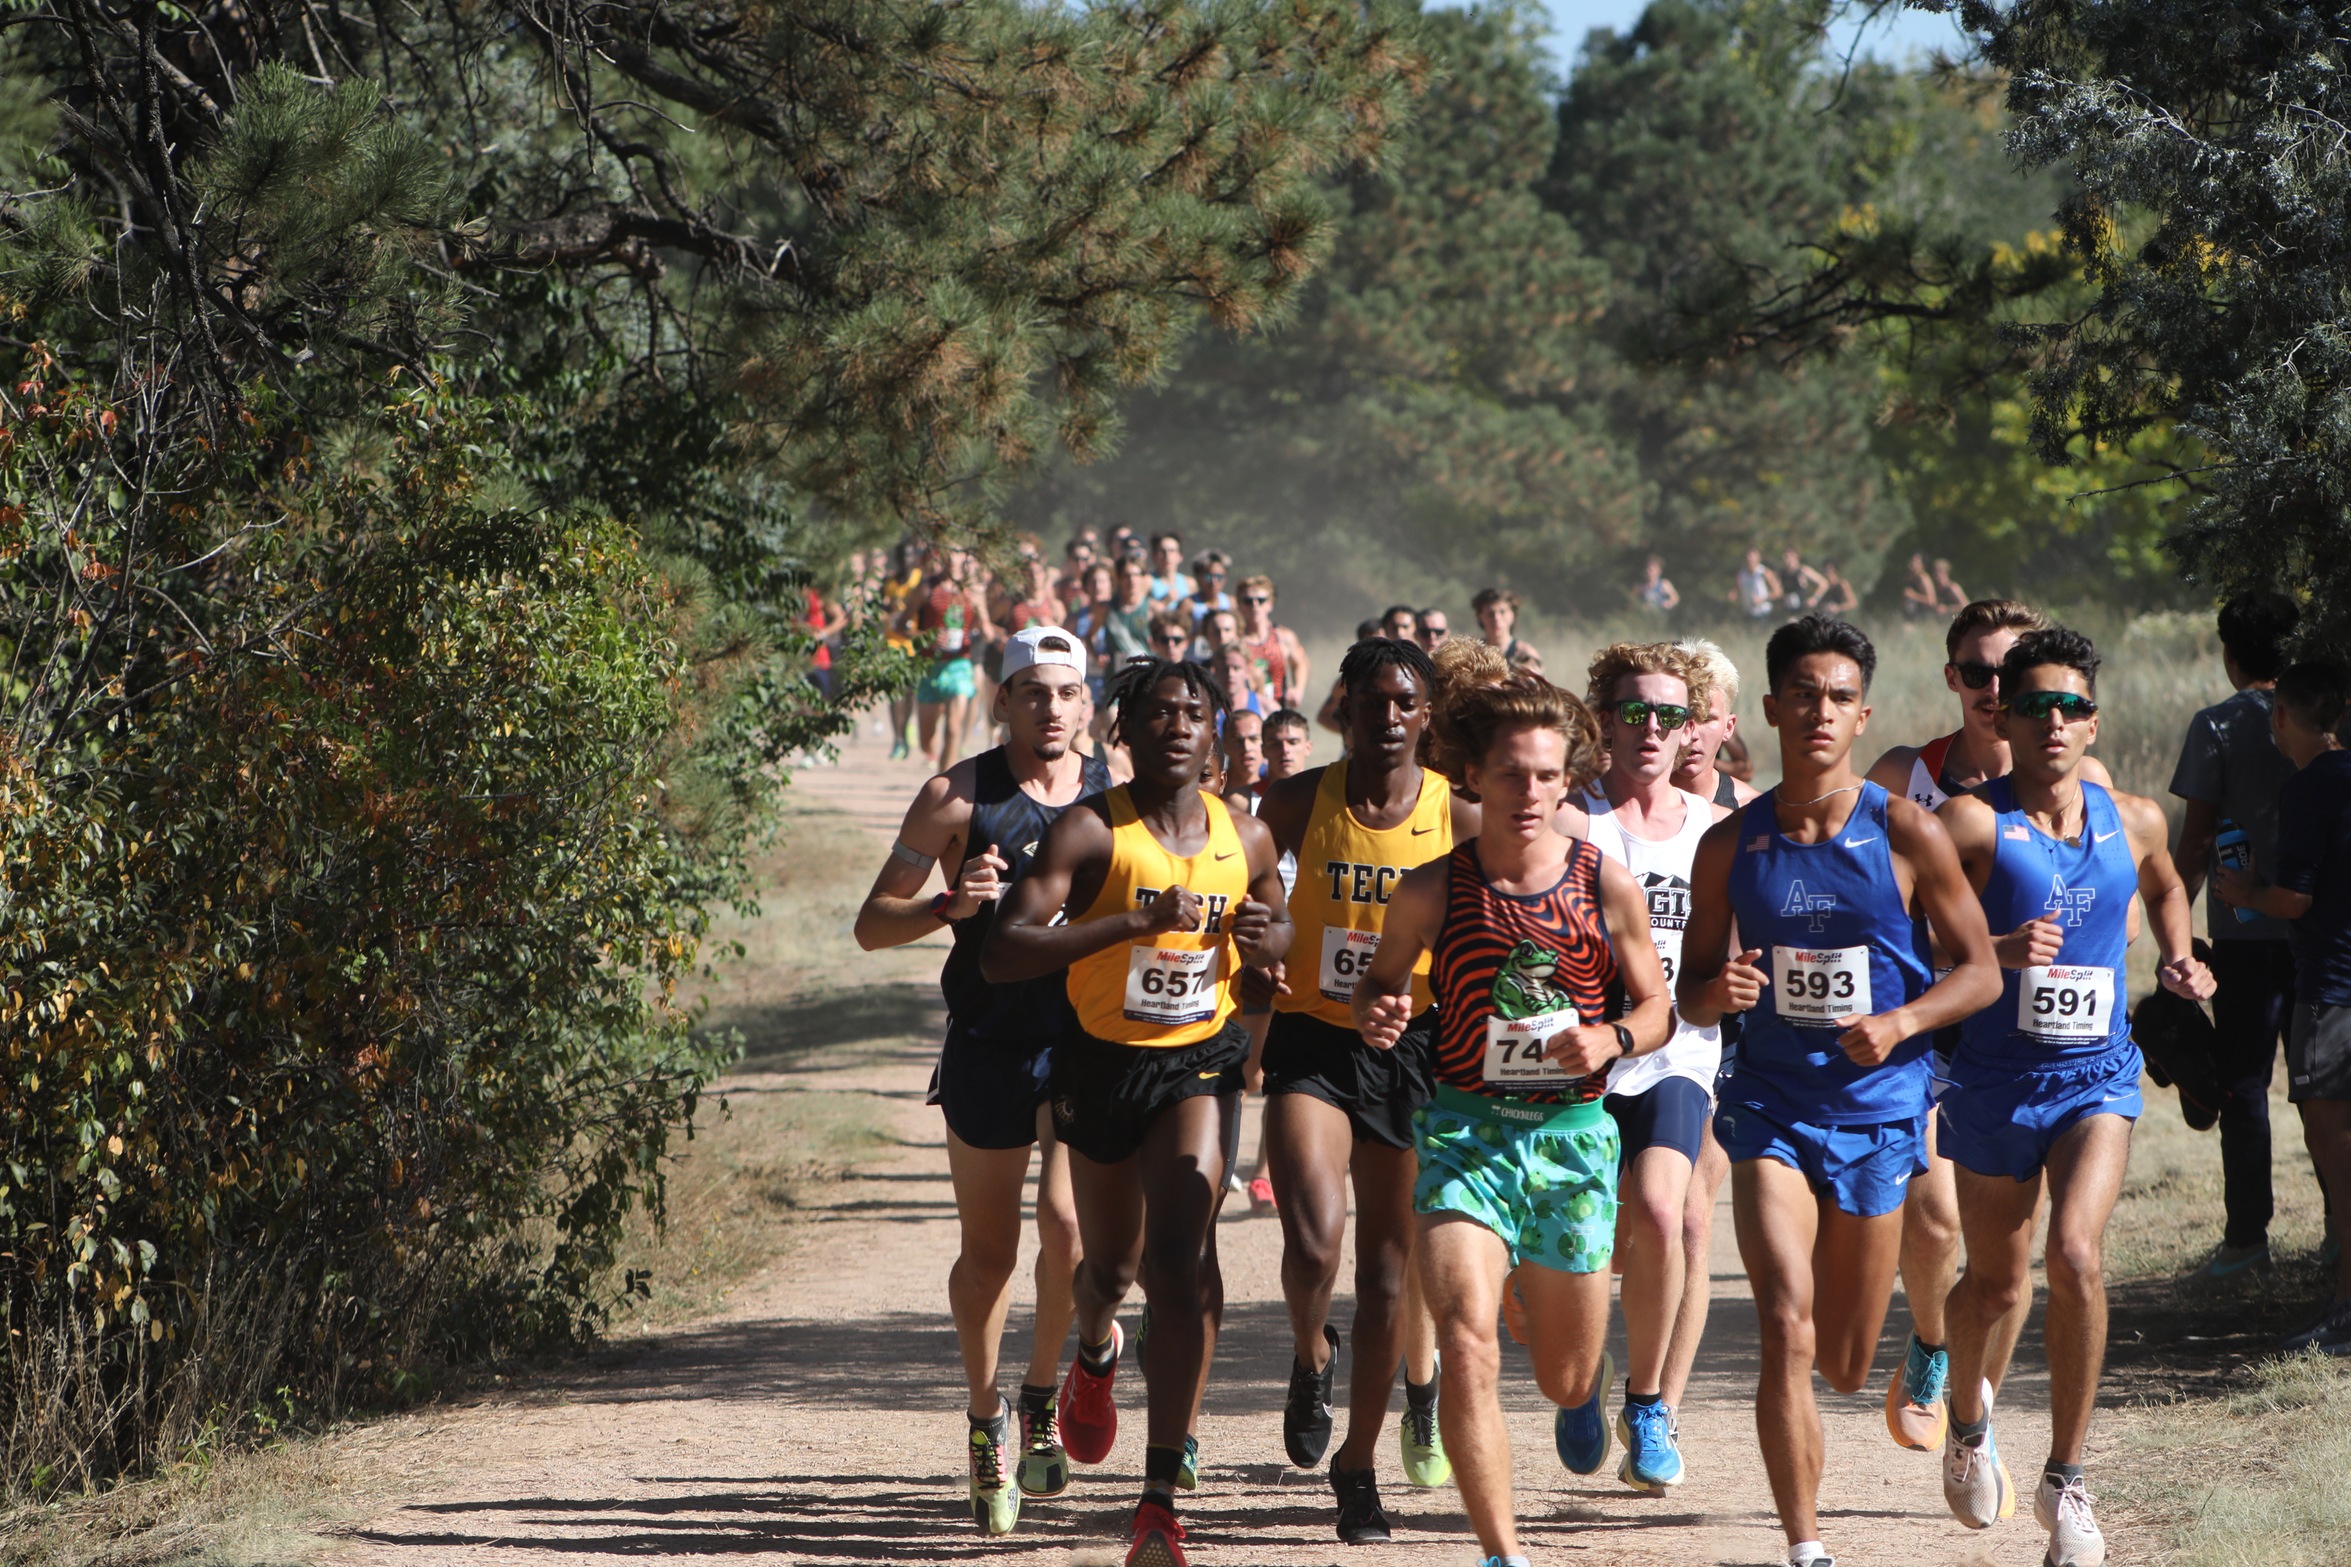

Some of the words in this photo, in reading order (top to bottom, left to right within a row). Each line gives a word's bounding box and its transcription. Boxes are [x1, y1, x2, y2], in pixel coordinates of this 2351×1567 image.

[1326, 861, 1414, 906] TEC
[1134, 886, 1229, 935] TH
[1780, 880, 1836, 933] AF
[2044, 874, 2096, 927] AF
[1156, 951, 1205, 966] MileSplit
[1795, 951, 1842, 965] MileSplit
[1141, 967, 1208, 998] 657
[1786, 969, 1855, 1000] 593
[2047, 968, 2093, 982] MileSplit
[1140, 998, 1180, 1011] Heartland
[1181, 999, 1200, 1011] Timing
[1788, 1002, 1826, 1014] Heartland
[1827, 1004, 1853, 1014] Timing
[2032, 986, 2096, 1017] 591
[1507, 1016, 1555, 1032] MileSplit
[2032, 1018, 2071, 1030] Heartland
[2072, 1021, 2094, 1031] Timing
[1496, 1038, 1544, 1064] 74
[1500, 1068, 1540, 1076] Heartland
